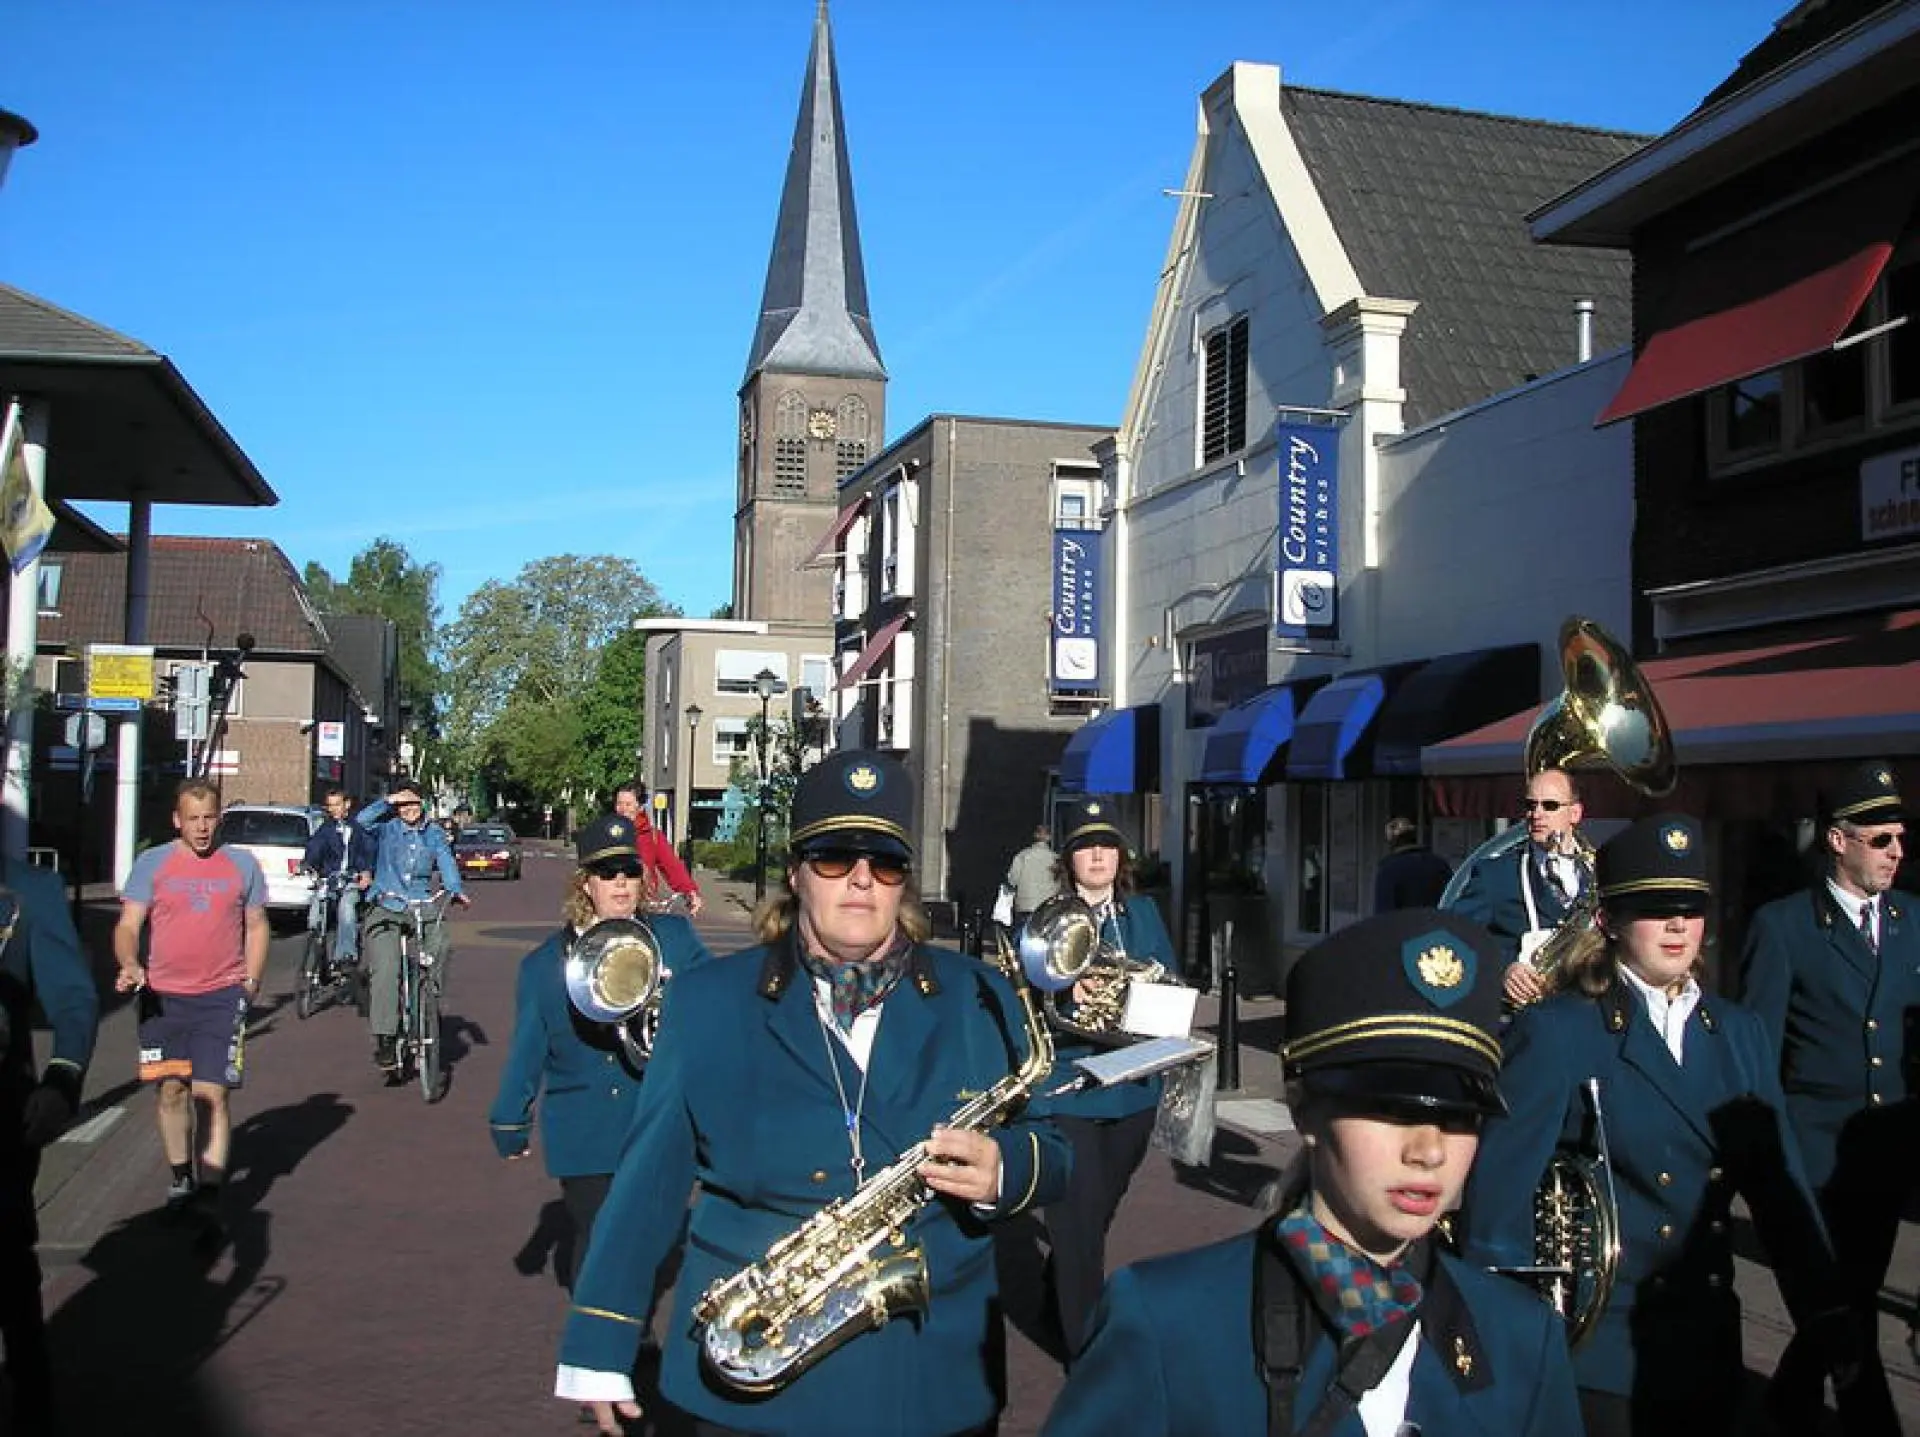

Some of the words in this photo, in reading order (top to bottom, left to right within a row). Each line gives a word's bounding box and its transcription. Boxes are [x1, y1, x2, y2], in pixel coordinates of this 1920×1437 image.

[1283, 436, 1319, 563] Country
[1315, 479, 1328, 565] wishes
[1056, 537, 1085, 634] Country
